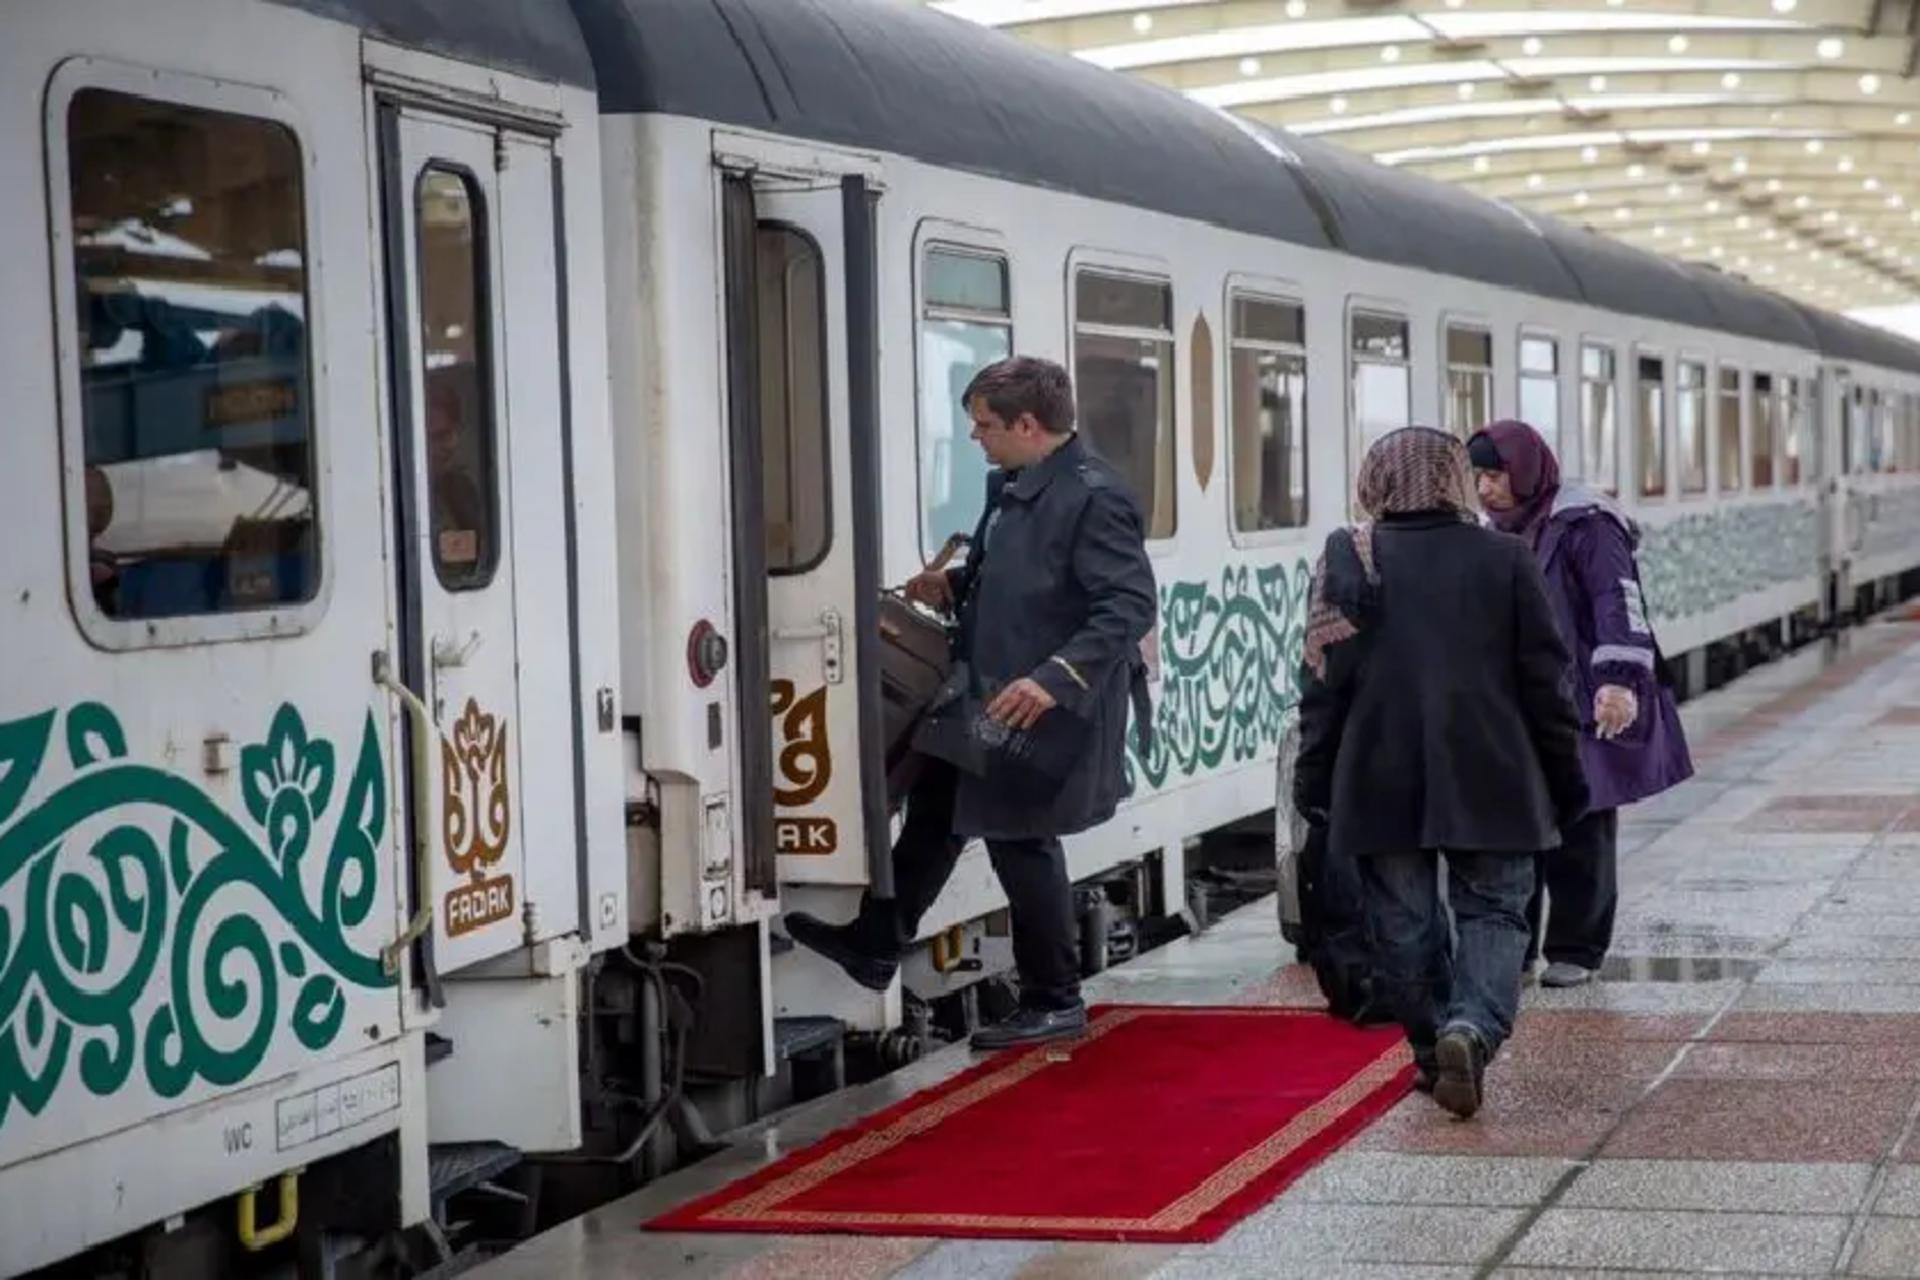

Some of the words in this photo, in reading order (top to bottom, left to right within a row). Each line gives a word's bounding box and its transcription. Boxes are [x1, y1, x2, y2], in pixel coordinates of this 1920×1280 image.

[776, 823, 830, 849] AK
[448, 884, 510, 928] FADAK
[223, 1121, 253, 1156] WC
